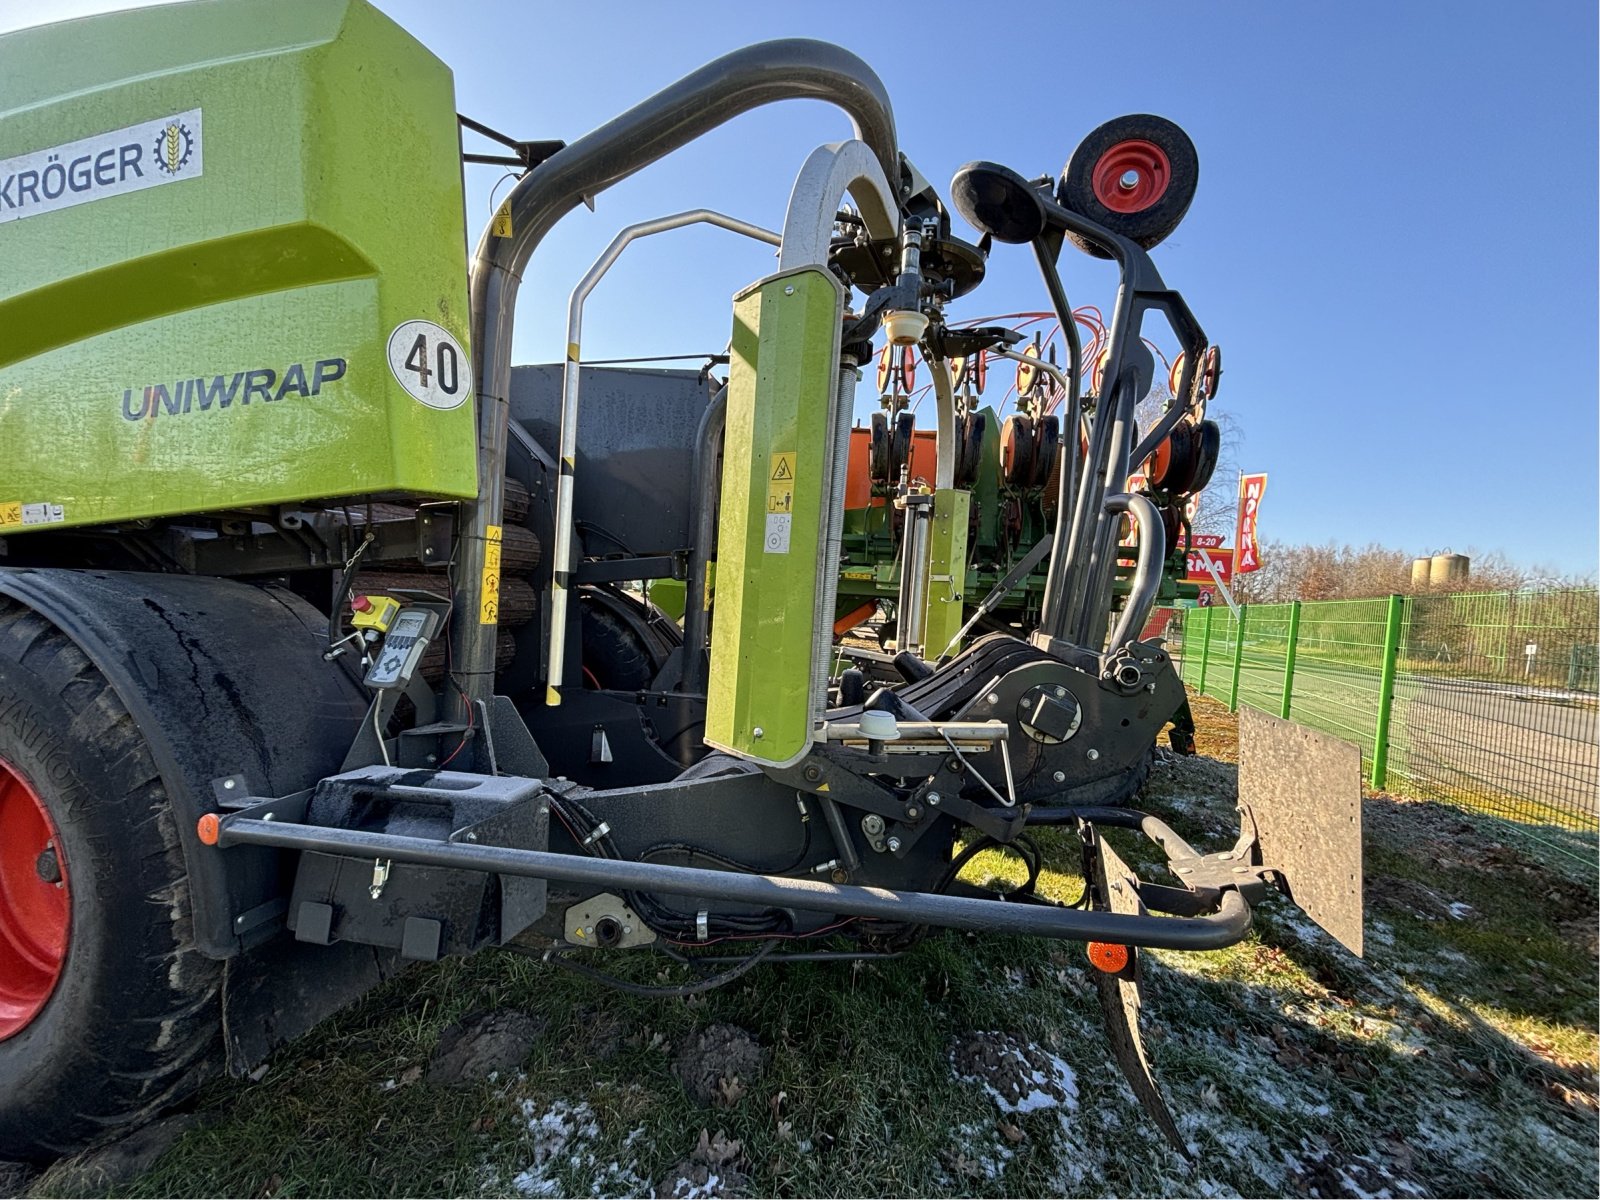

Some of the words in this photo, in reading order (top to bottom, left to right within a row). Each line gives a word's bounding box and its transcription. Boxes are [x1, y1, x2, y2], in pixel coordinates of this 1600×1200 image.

[0, 143, 144, 211] KRÖGER
[122, 357, 347, 421] UNIWRAP
[404, 333, 459, 395] 40
[1187, 558, 1225, 573] RMA
[1196, 537, 1217, 546] 8-20
